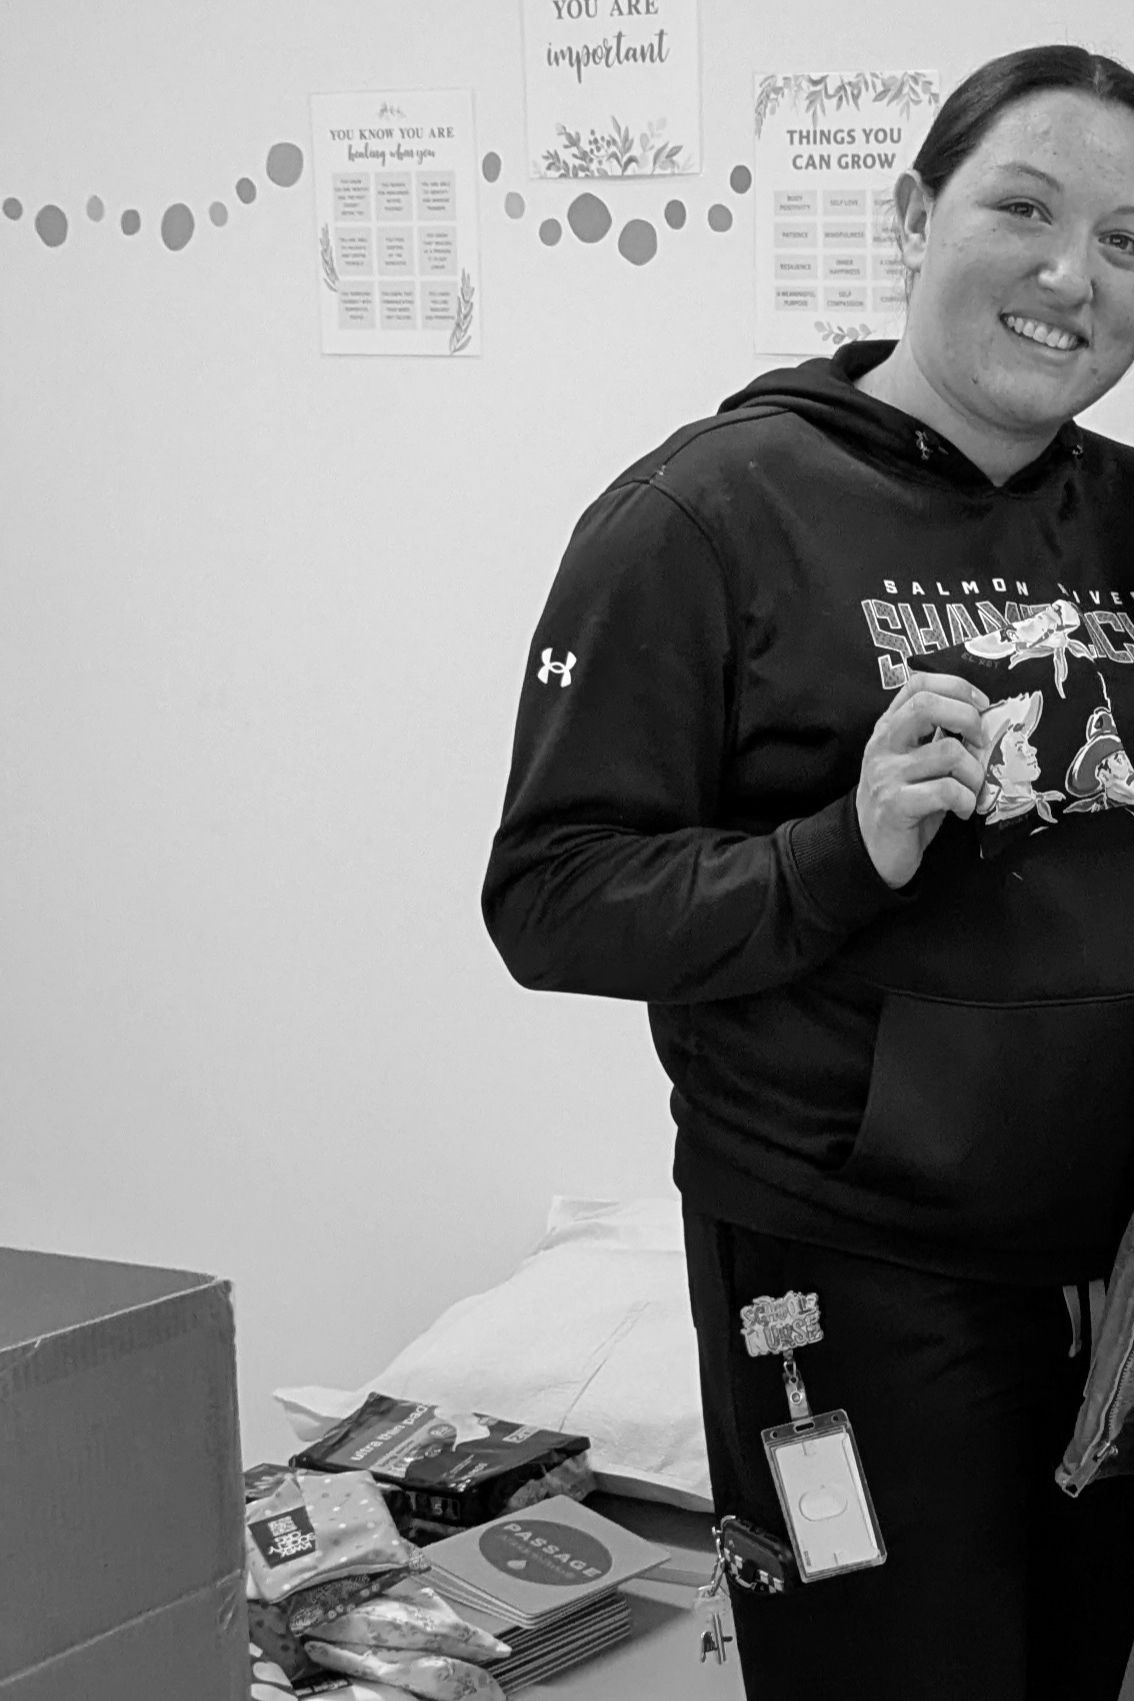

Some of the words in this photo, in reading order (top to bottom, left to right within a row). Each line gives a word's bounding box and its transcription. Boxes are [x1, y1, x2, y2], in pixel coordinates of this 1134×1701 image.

[552, 0, 598, 20] YOU
[610, 0, 659, 17] ARE
[547, 28, 671, 84] important
[329, 129, 354, 141] YOU
[359, 128, 395, 140] KNOW
[400, 127, 424, 139] YOU
[428, 126, 455, 138] ARE
[786, 129, 856, 146] THINGS
[862, 127, 902, 144] YOU
[792, 153, 831, 170] CAN
[837, 153, 896, 170] GROW
[883, 578, 1029, 597] SALMON
[350, 1440, 383, 1461] ultra
[503, 1523, 602, 1577] PASSAGE
